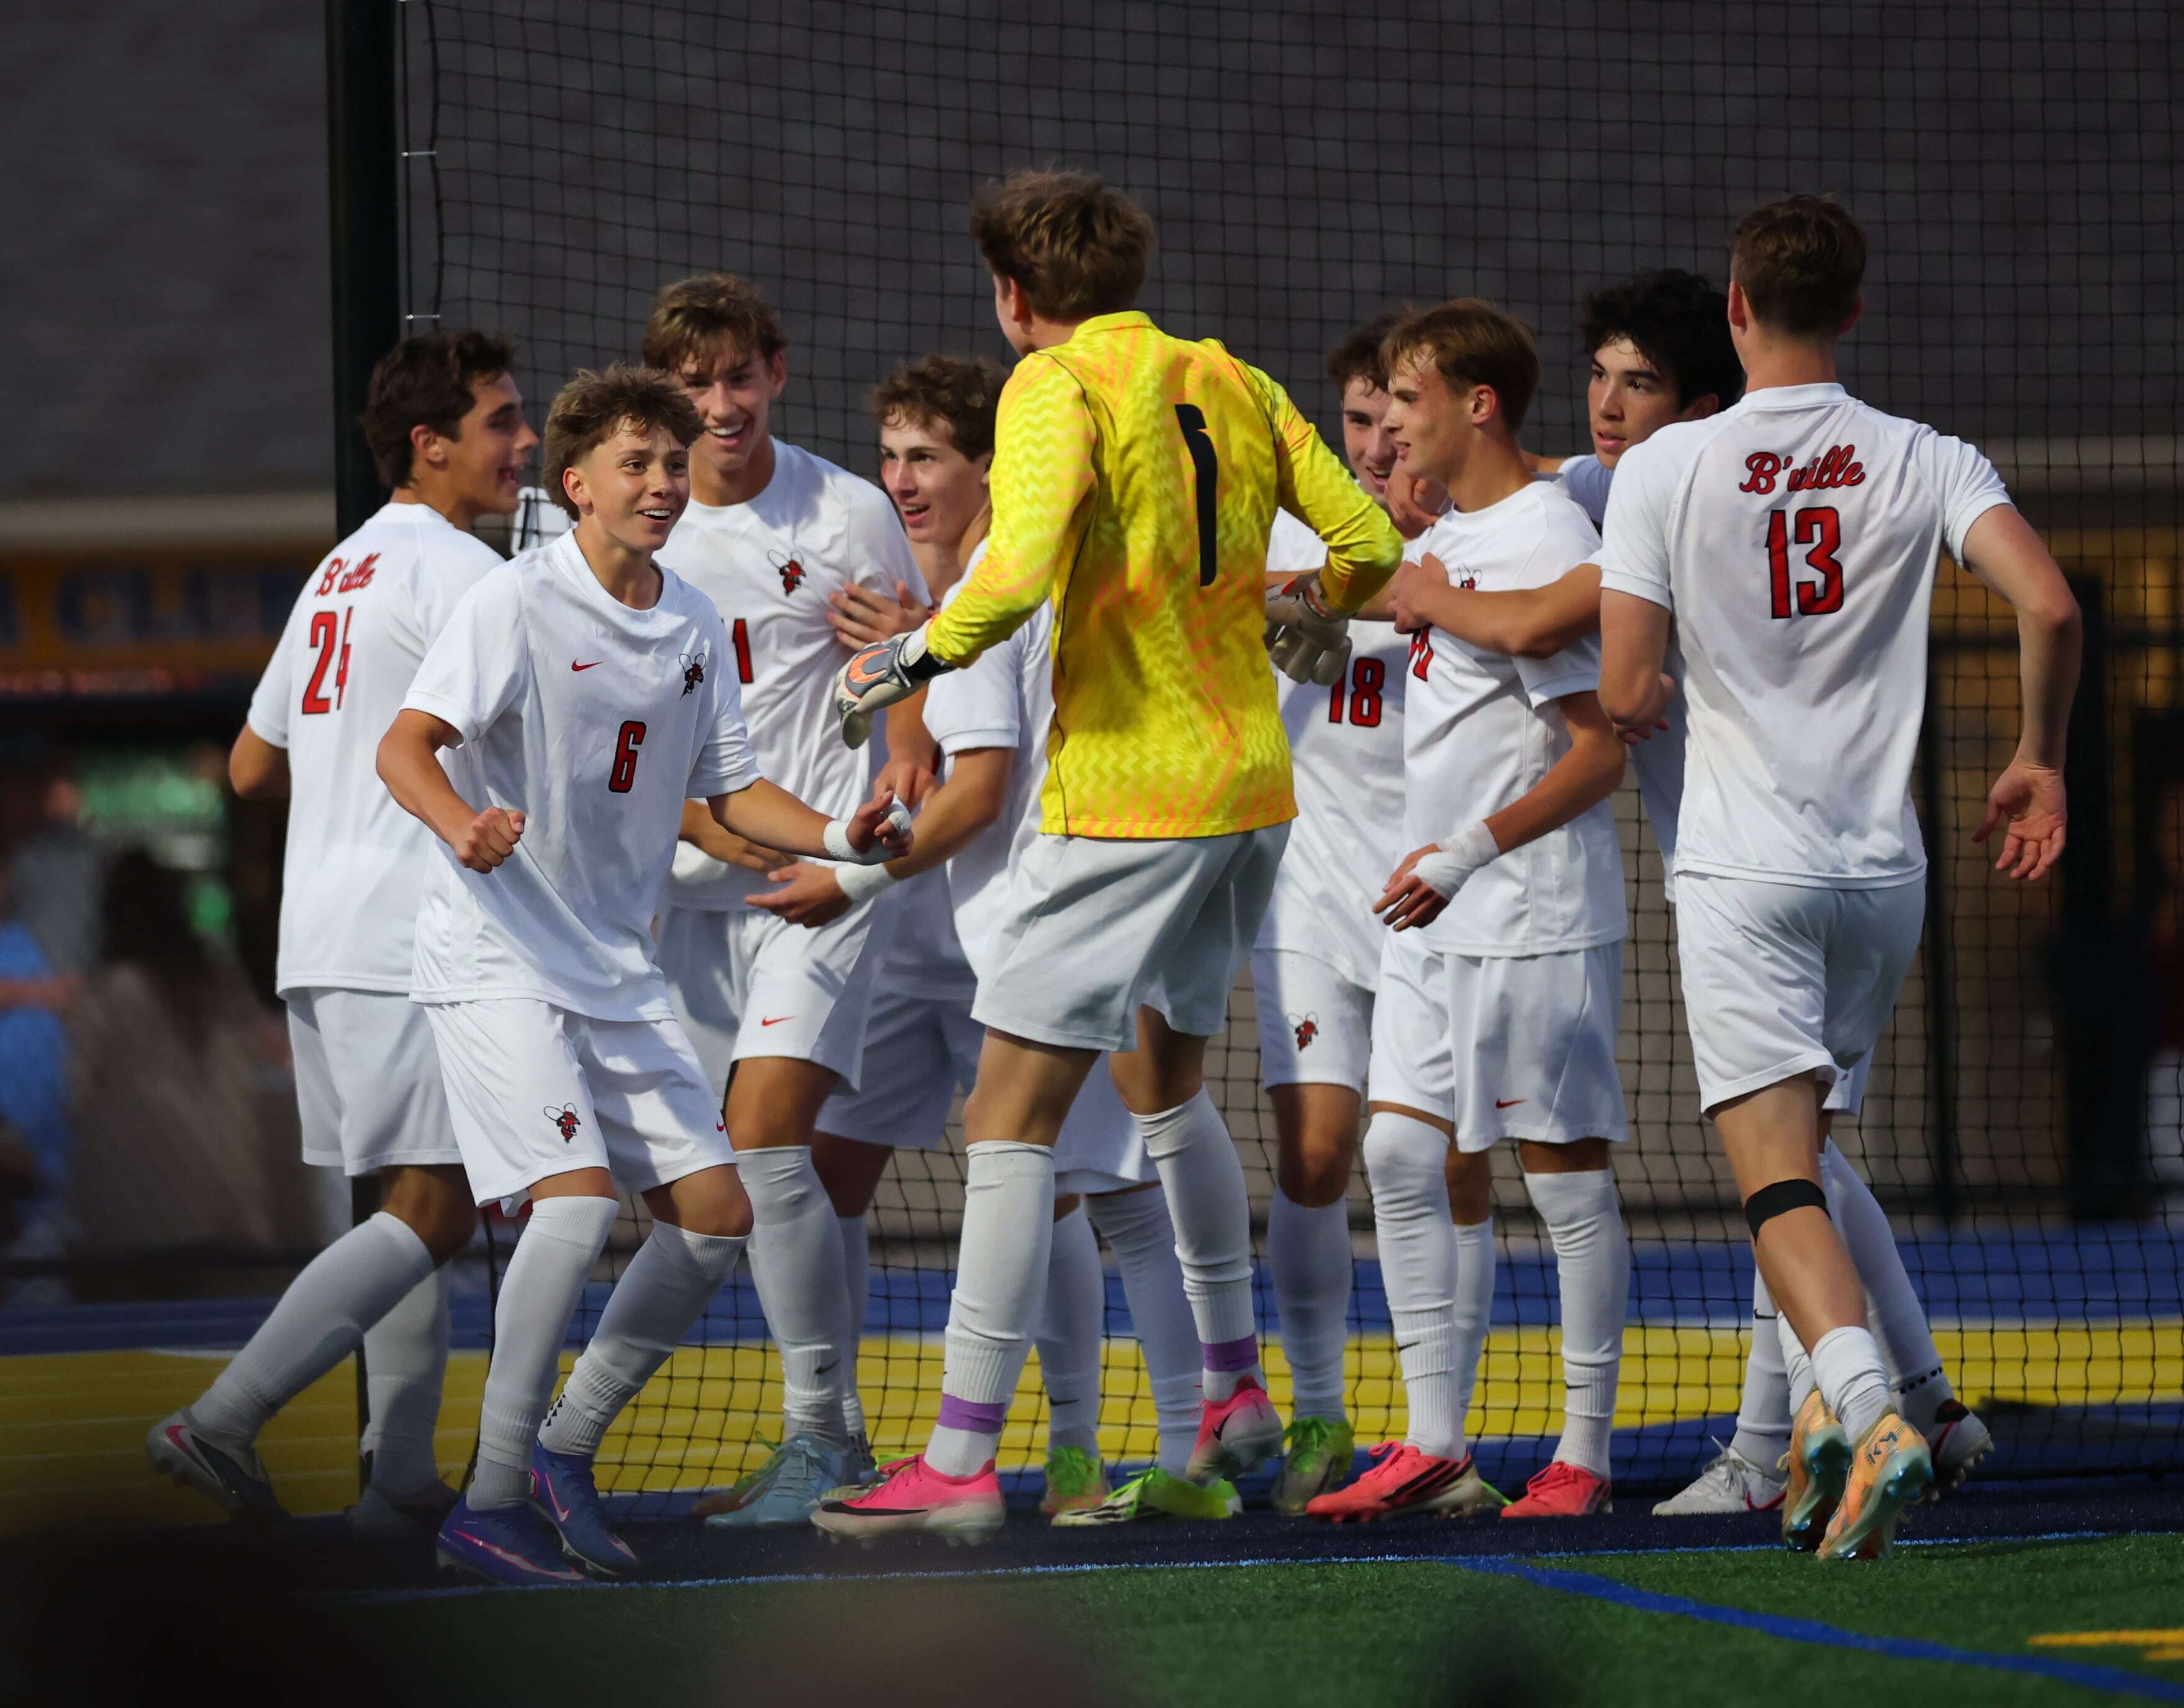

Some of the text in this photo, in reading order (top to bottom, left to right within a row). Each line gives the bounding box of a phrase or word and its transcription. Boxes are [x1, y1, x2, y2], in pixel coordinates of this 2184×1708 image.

[1174, 404, 1218, 587] 1
[1739, 444, 1866, 494] B'ville
[1765, 506, 1844, 619] 13
[302, 606, 353, 715] 24
[1328, 656, 1385, 727] 18
[609, 720, 646, 793] 6
